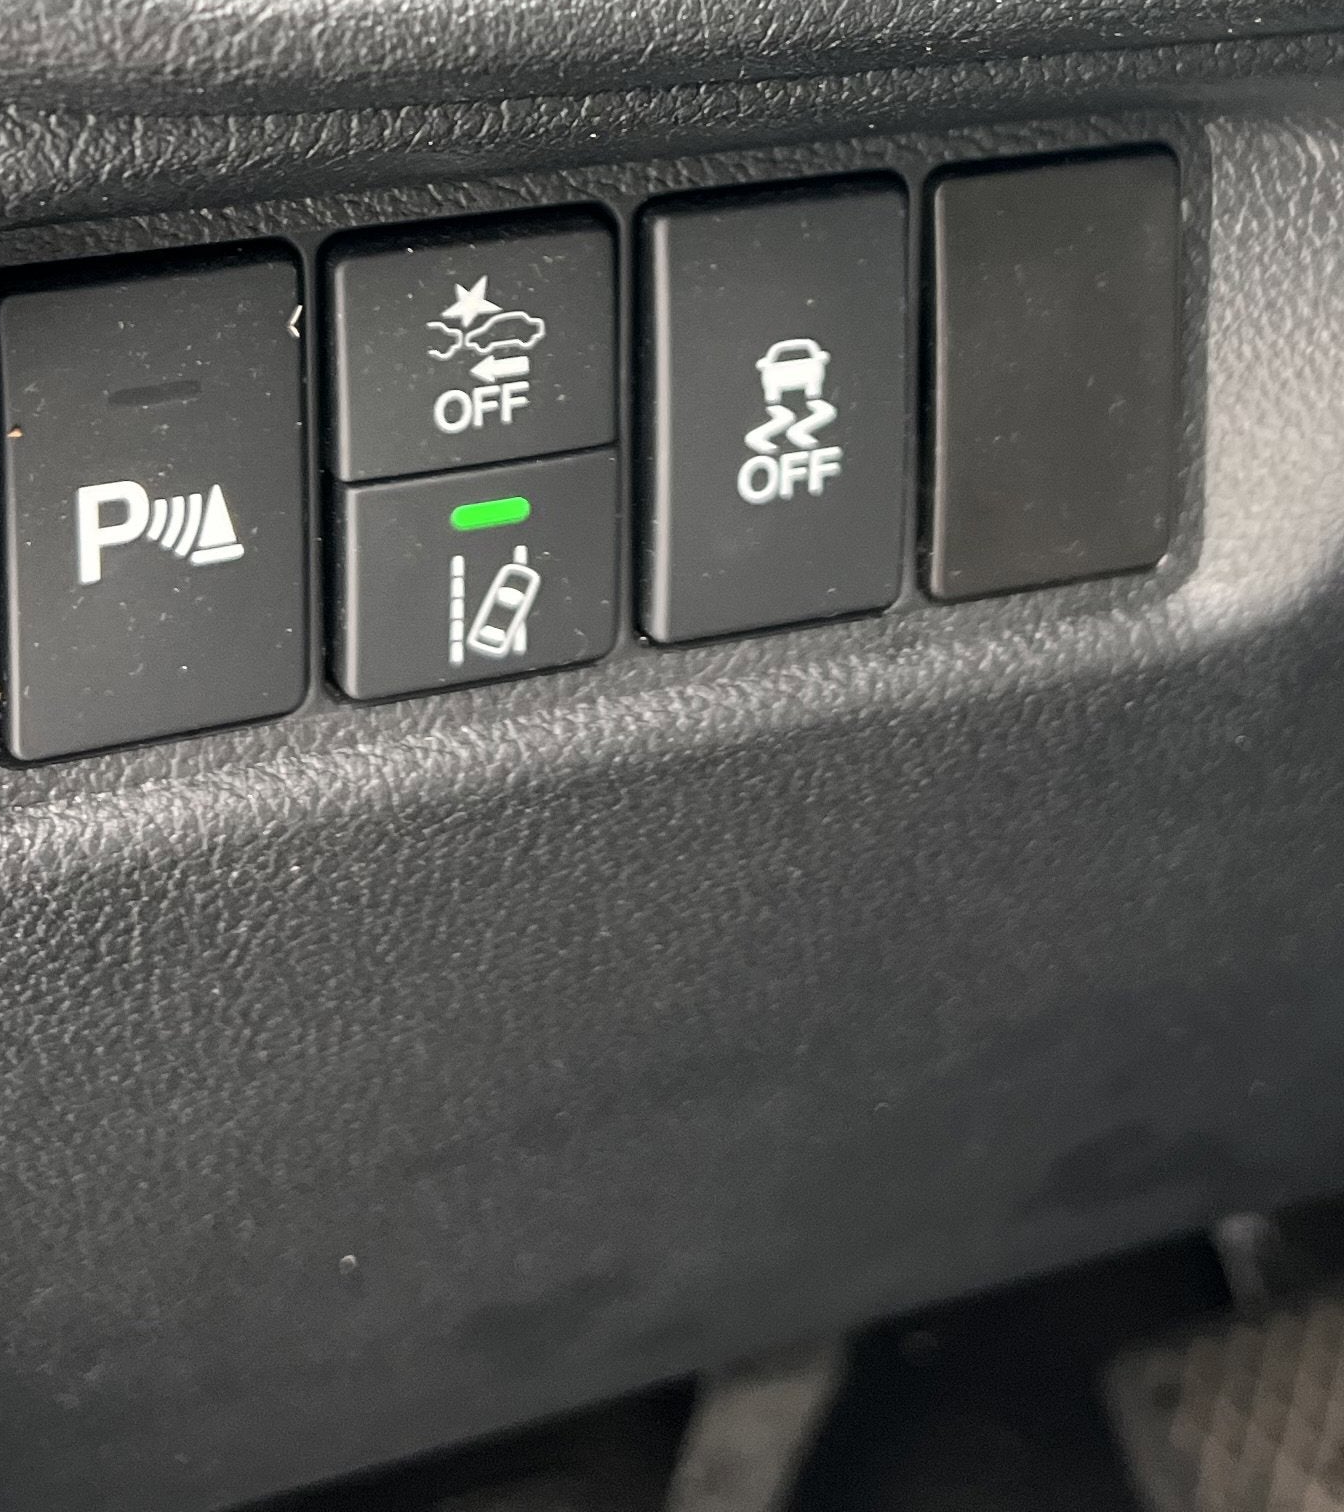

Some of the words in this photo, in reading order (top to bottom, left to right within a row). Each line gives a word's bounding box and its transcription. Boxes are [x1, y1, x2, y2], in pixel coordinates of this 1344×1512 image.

[433, 381, 530, 433] OFF
[737, 445, 842, 505] OFF
[75, 480, 151, 585] P
